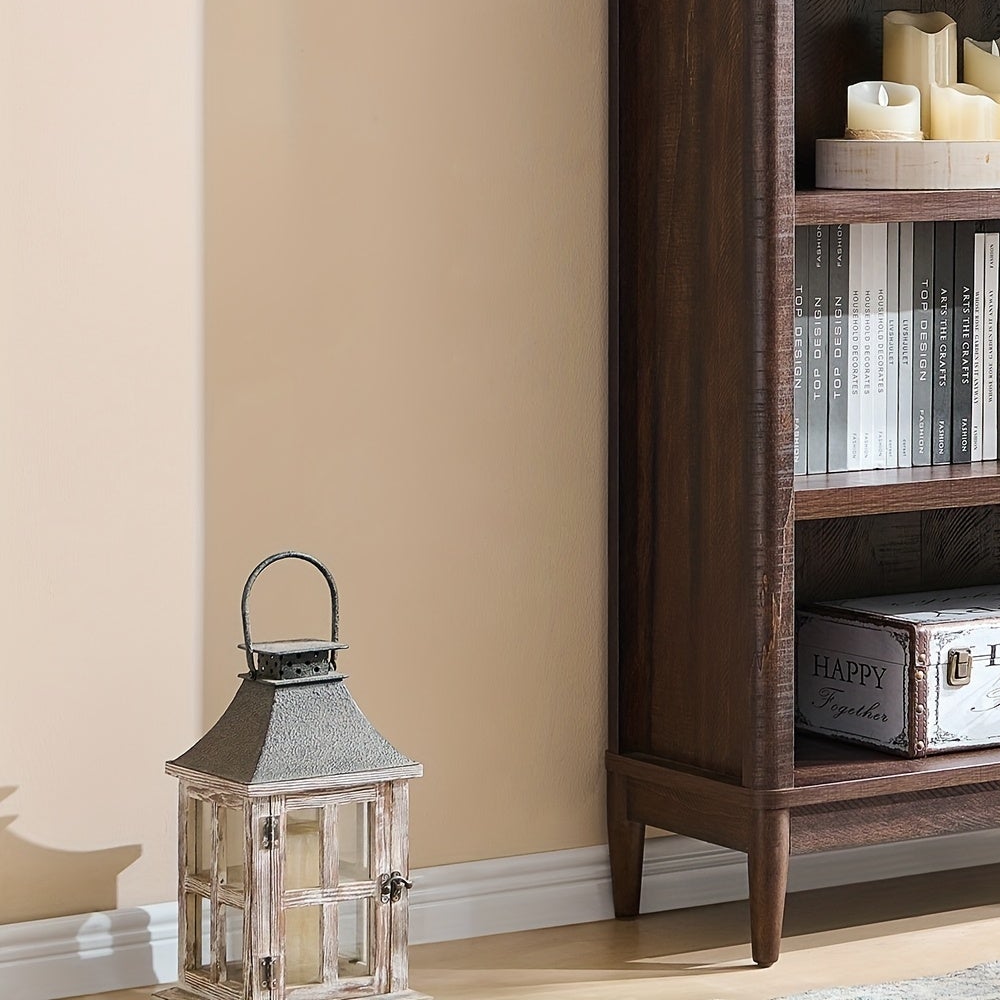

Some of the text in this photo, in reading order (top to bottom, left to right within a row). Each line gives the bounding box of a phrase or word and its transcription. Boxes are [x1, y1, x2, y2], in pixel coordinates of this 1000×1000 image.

[795, 284, 804, 319] TOP
[852, 290, 860, 342] HOUSEHOLD
[877, 288, 885, 341] HOUSEHOLD
[920, 279, 929, 313] TOP
[940, 288, 948, 316] ARTS
[962, 286, 971, 314] ARTS
[813, 296, 823, 359] DESIGN
[833, 295, 843, 358] DESIGN
[939, 318, 948, 341] THE
[962, 316, 970, 339] THE
[794, 324, 803, 390] DESIGN
[851, 344, 859, 395] DECORATES
[863, 344, 871, 395] DECORATES
[919, 320, 928, 381] DESIGN
[939, 344, 947, 387] CRAFTS
[961, 341, 970, 384] CRAFTS
[813, 368, 822, 401] TOP
[833, 367, 842, 400] TOP
[812, 653, 888, 690] HAPPY
